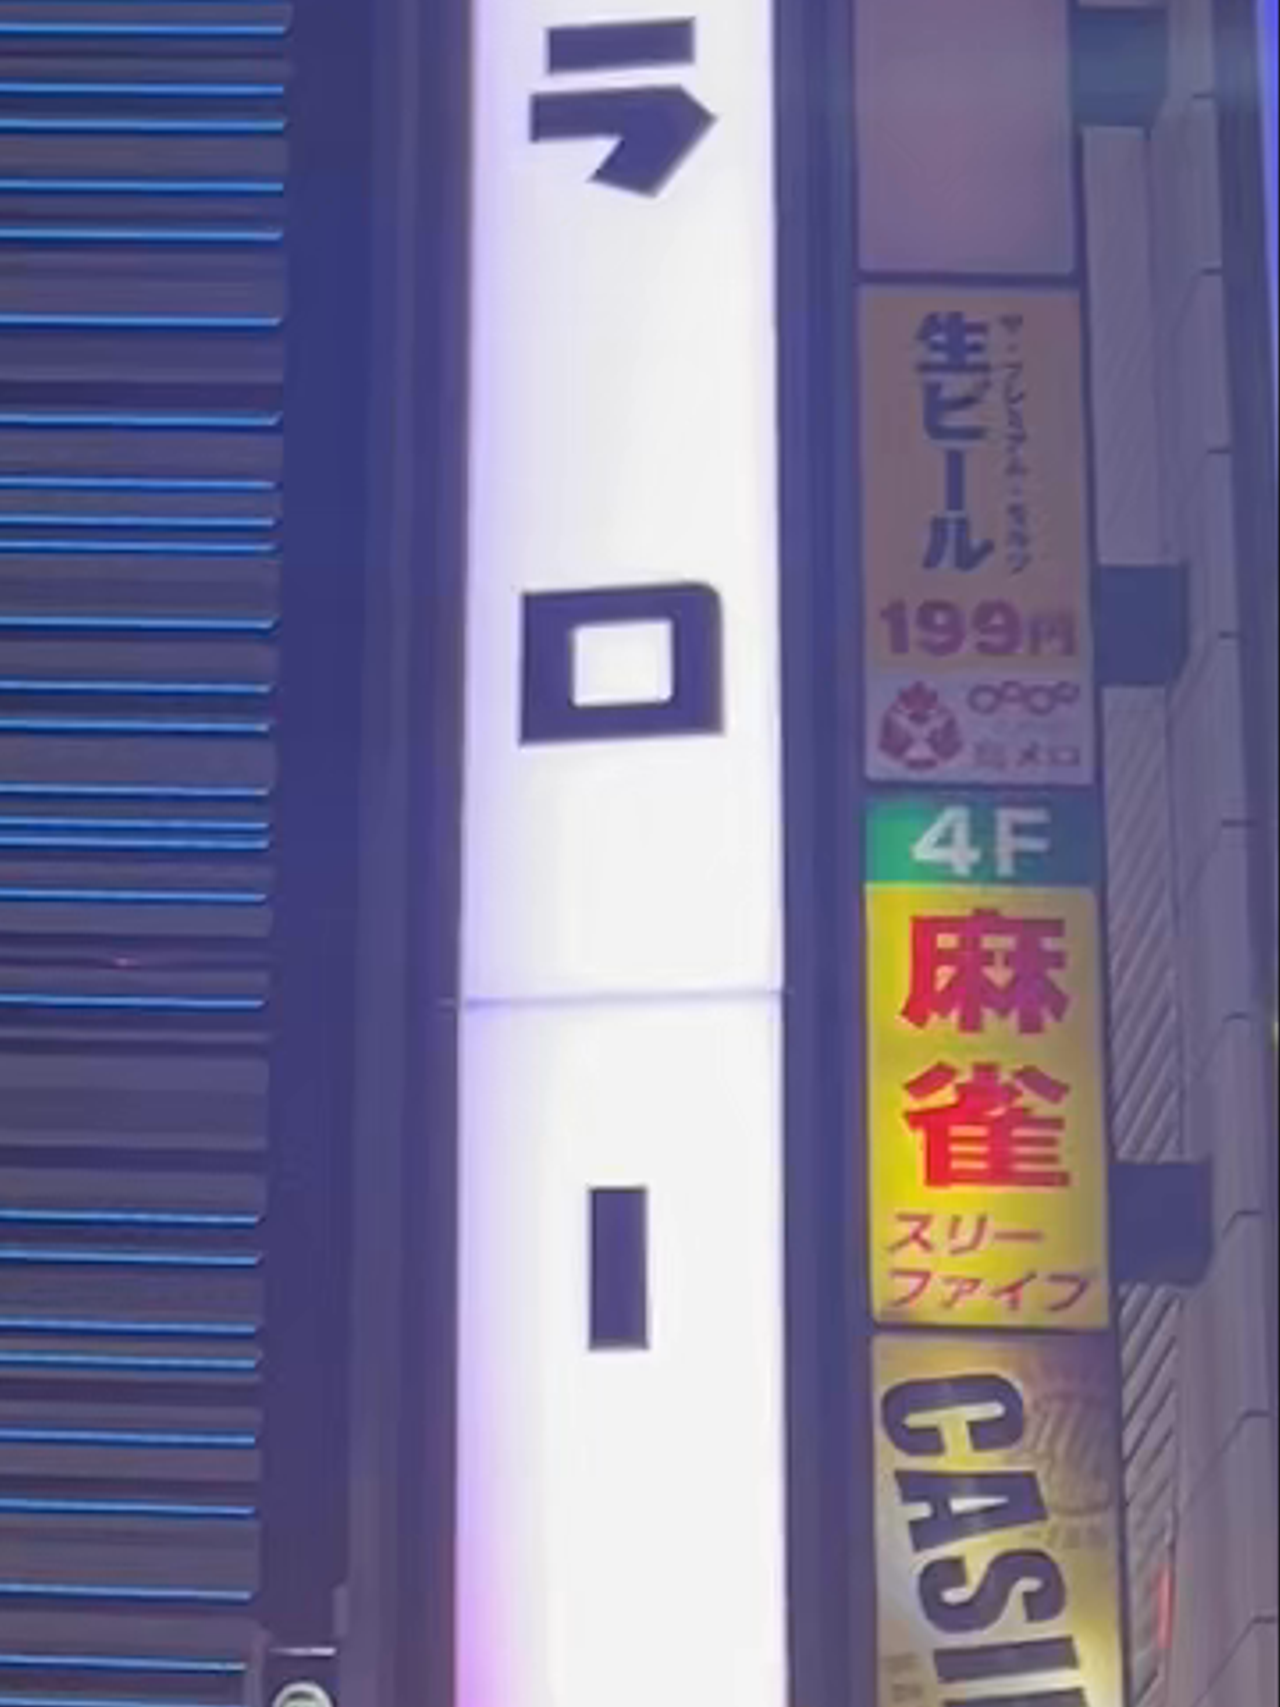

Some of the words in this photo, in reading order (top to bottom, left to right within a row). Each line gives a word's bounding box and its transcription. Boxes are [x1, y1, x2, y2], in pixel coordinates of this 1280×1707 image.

[914, 310, 995, 573] 生ビール
[911, 804, 1052, 879] 4F
[898, 907, 1071, 1188] 麻雀
[886, 1212, 1045, 1256] スリー
